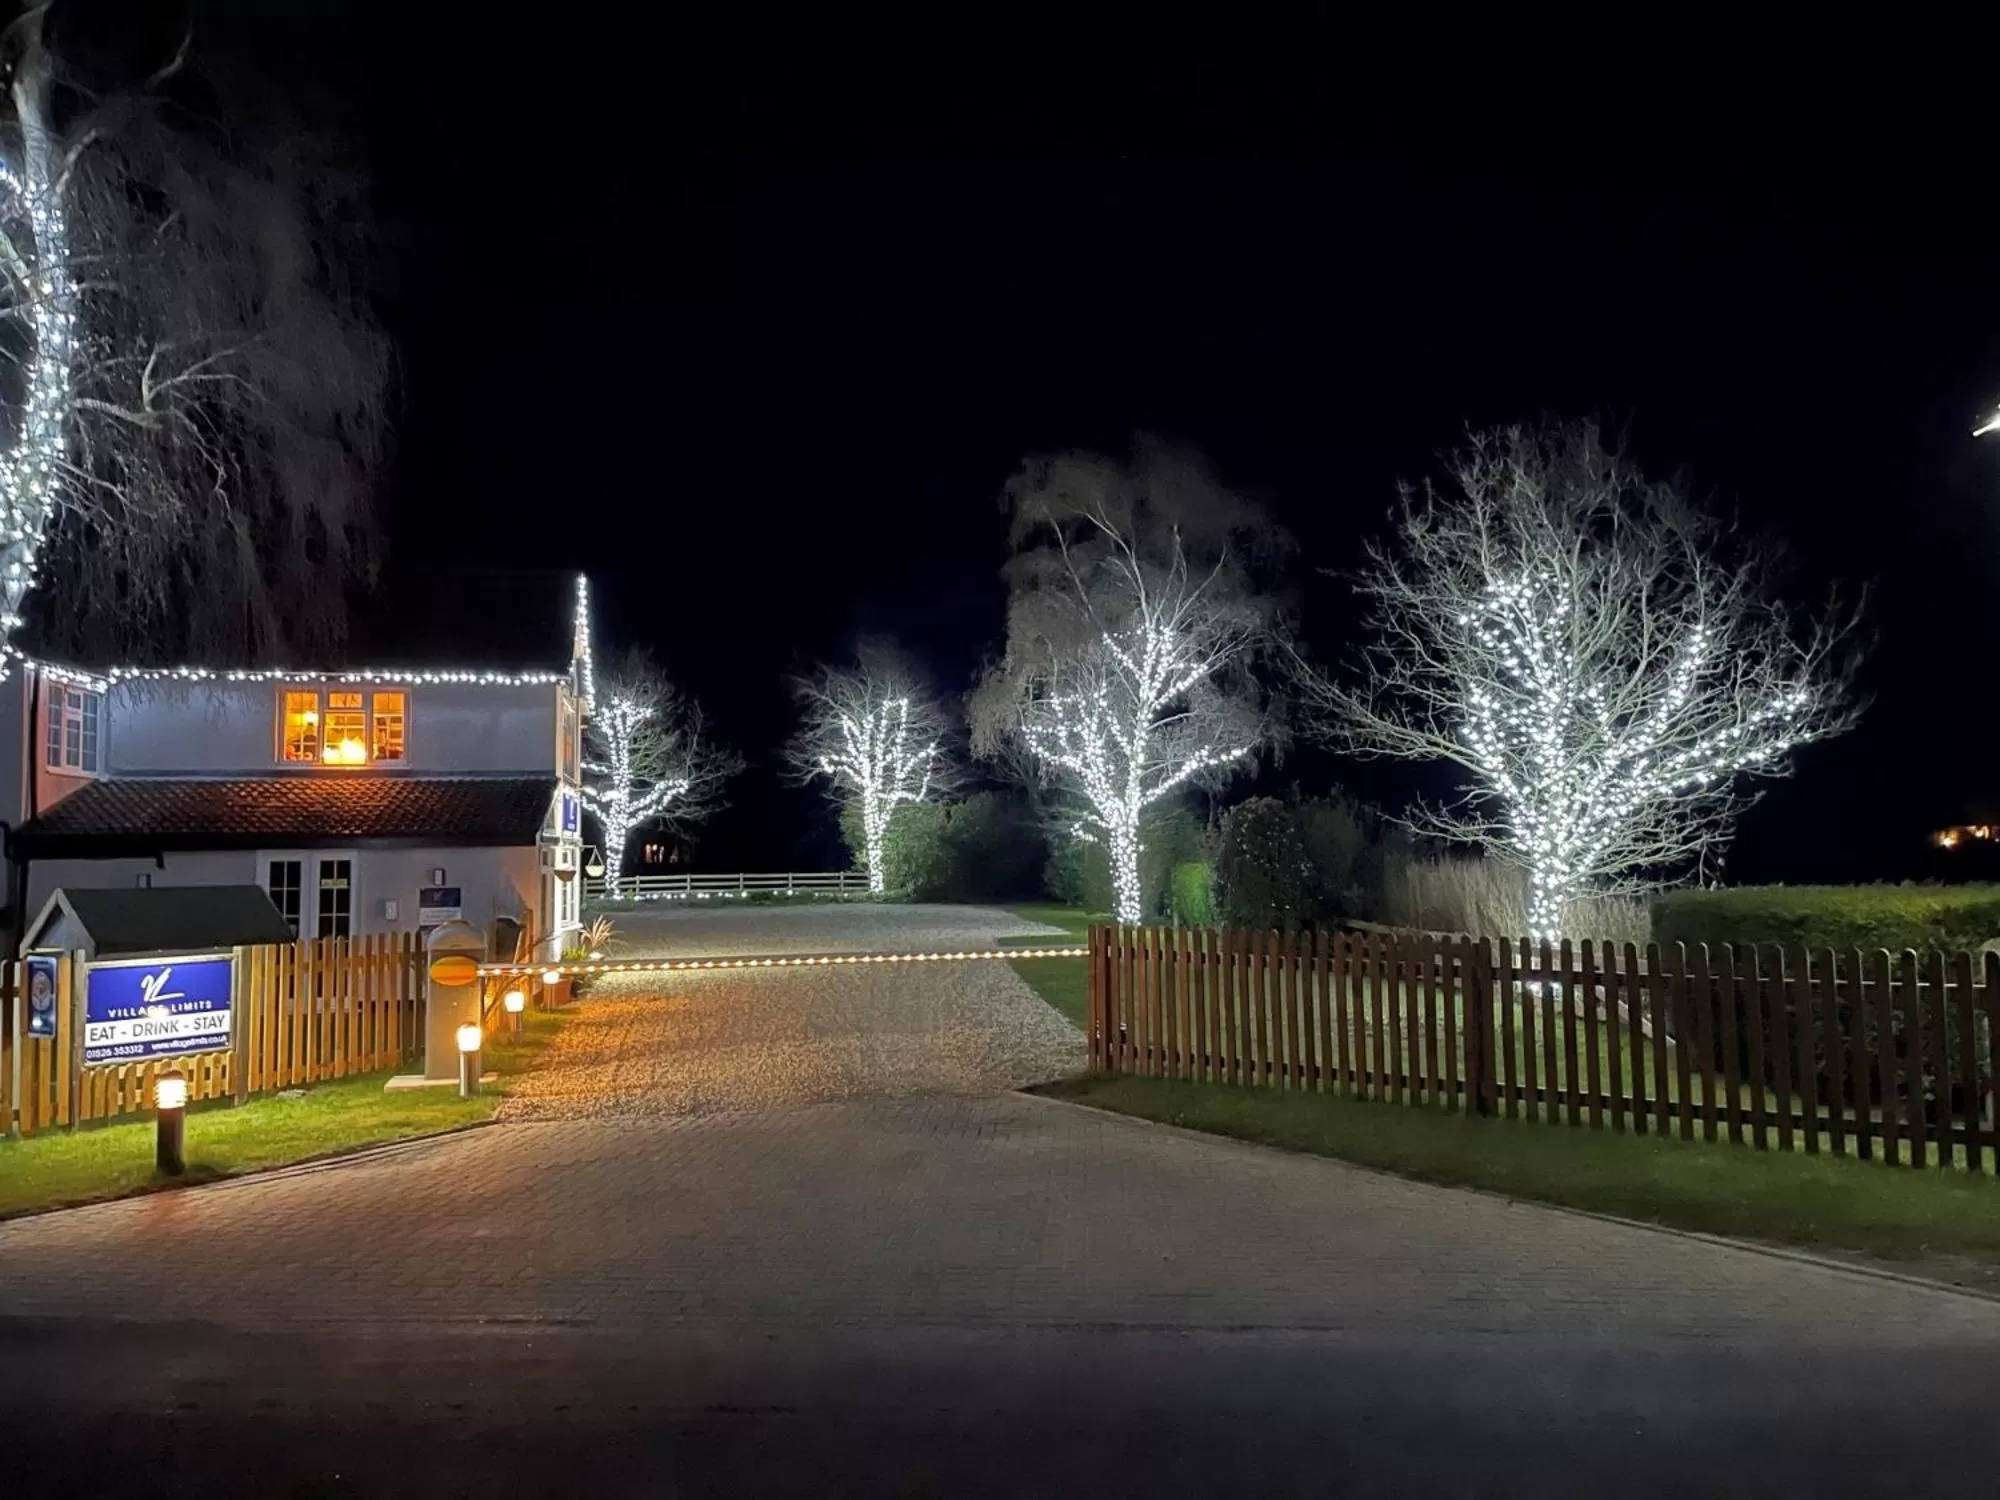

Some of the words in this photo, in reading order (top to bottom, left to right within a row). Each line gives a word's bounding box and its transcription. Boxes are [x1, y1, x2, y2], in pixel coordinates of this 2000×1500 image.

[108, 1005, 165, 1018] VILLA
[171, 1000, 213, 1013] LIMITS
[90, 1026, 117, 1041] EAT
[132, 1019, 180, 1037] DRINK
[193, 1015, 225, 1031] STAY
